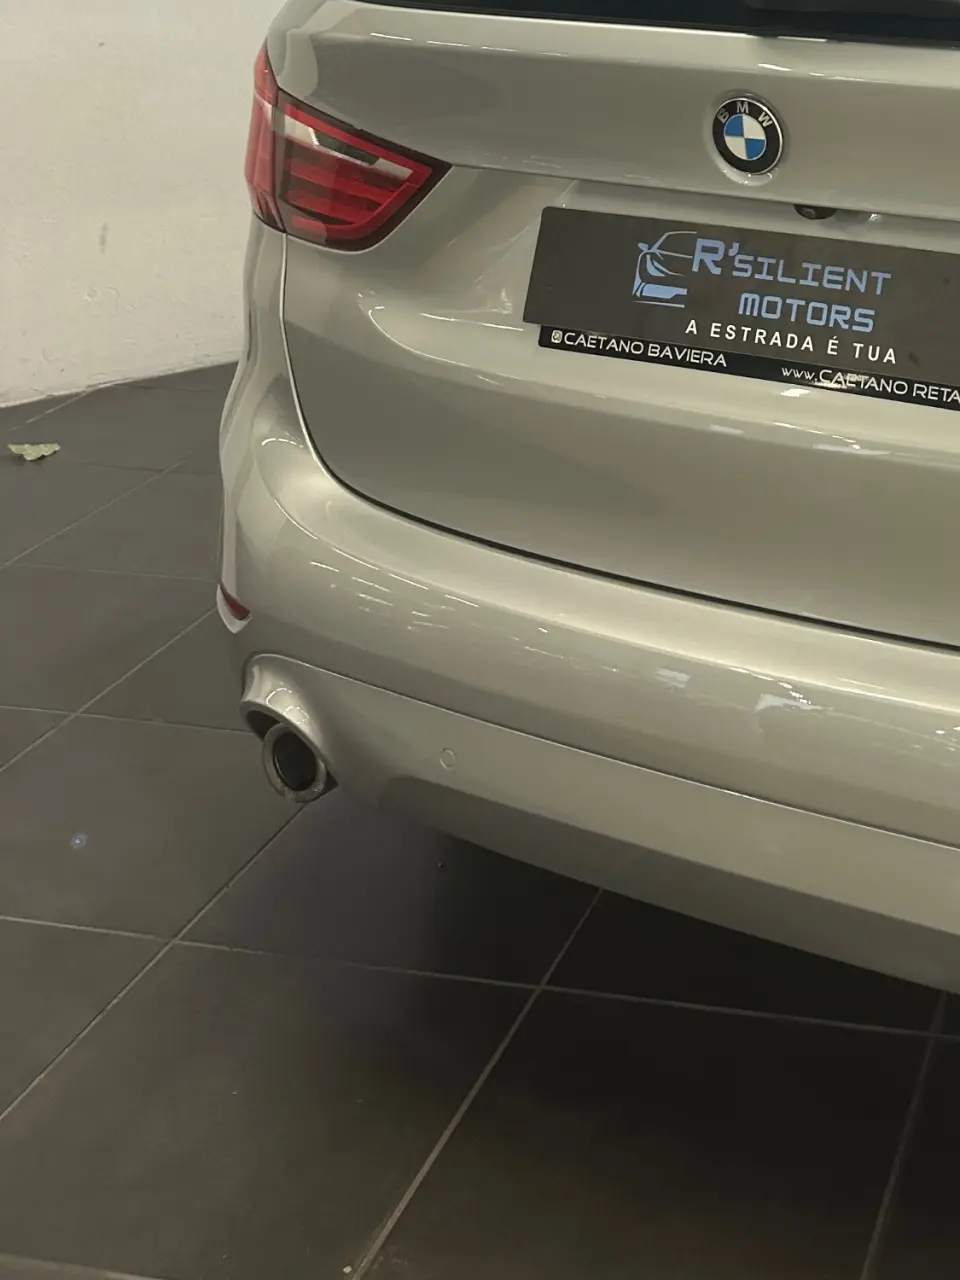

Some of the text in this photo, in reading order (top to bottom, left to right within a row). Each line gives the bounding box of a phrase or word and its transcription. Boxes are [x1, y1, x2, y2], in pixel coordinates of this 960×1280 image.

[717, 101, 773, 127] BMW
[692, 238, 892, 295] R'SILIENT
[738, 293, 876, 333] MOTORS
[564, 331, 727, 367] CAETANO BAVIERA
[685, 319, 896, 364] A ESTRADA É TUA
